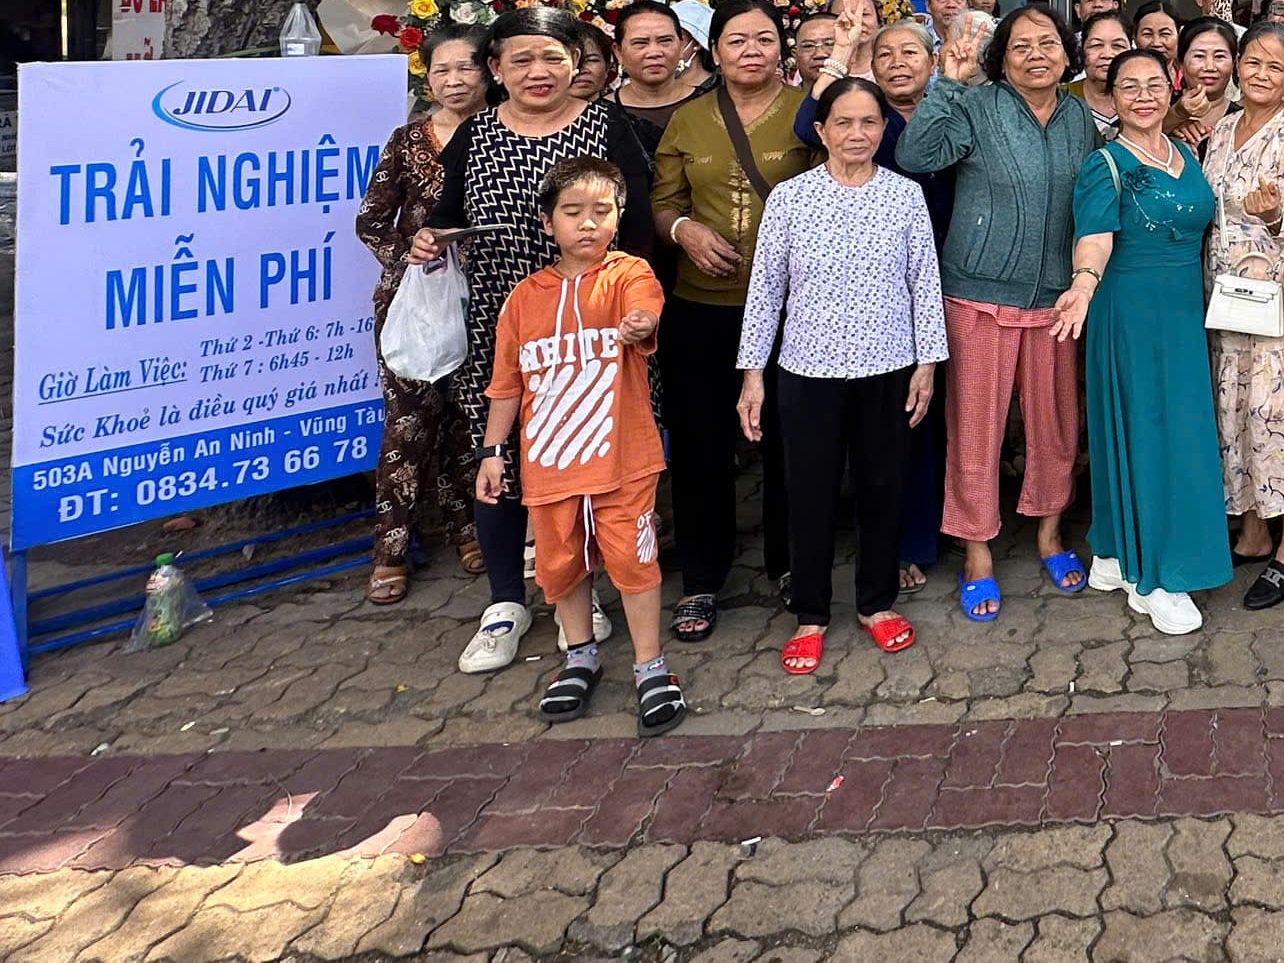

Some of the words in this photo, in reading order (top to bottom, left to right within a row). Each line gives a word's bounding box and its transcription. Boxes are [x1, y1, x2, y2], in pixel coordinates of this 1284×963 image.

[173, 88, 272, 116] JIDAI
[50, 138, 171, 225] TRẢI
[198, 133, 379, 214] NGHIỆM
[105, 232, 234, 330] MIỄN
[260, 231, 336, 310] PHÍ
[200, 336, 239, 358] Thứ
[242, 334, 254, 352] 2
[305, 324, 320, 342] 6:
[326, 321, 344, 340] 7h
[200, 362, 239, 384] Thứ
[244, 359, 254, 377] 7
[269, 350, 310, 372] 6h45
[326, 343, 354, 363] 12h
[519, 327, 619, 373] WHITE
[39, 370, 79, 402] Giờ
[84, 365, 131, 395] Làm
[138, 356, 188, 386] Việc:
[39, 422, 86, 449] Sức
[92, 407, 152, 439] Khoẻ
[159, 404, 181, 427] là
[188, 393, 237, 422] điều
[242, 386, 280, 416] quý
[284, 378, 318, 408] giá
[324, 369, 370, 395] nhất
[33, 461, 93, 492] 503A
[102, 441, 186, 478] Nguyễn
[193, 438, 222, 460] An
[229, 426, 276, 452] Ninh
[299, 415, 348, 439] Vũng
[58, 488, 119, 524] ĐT:
[136, 456, 271, 507] 0834.73
[283, 444, 321, 475] 66
[333, 435, 369, 465] 78
